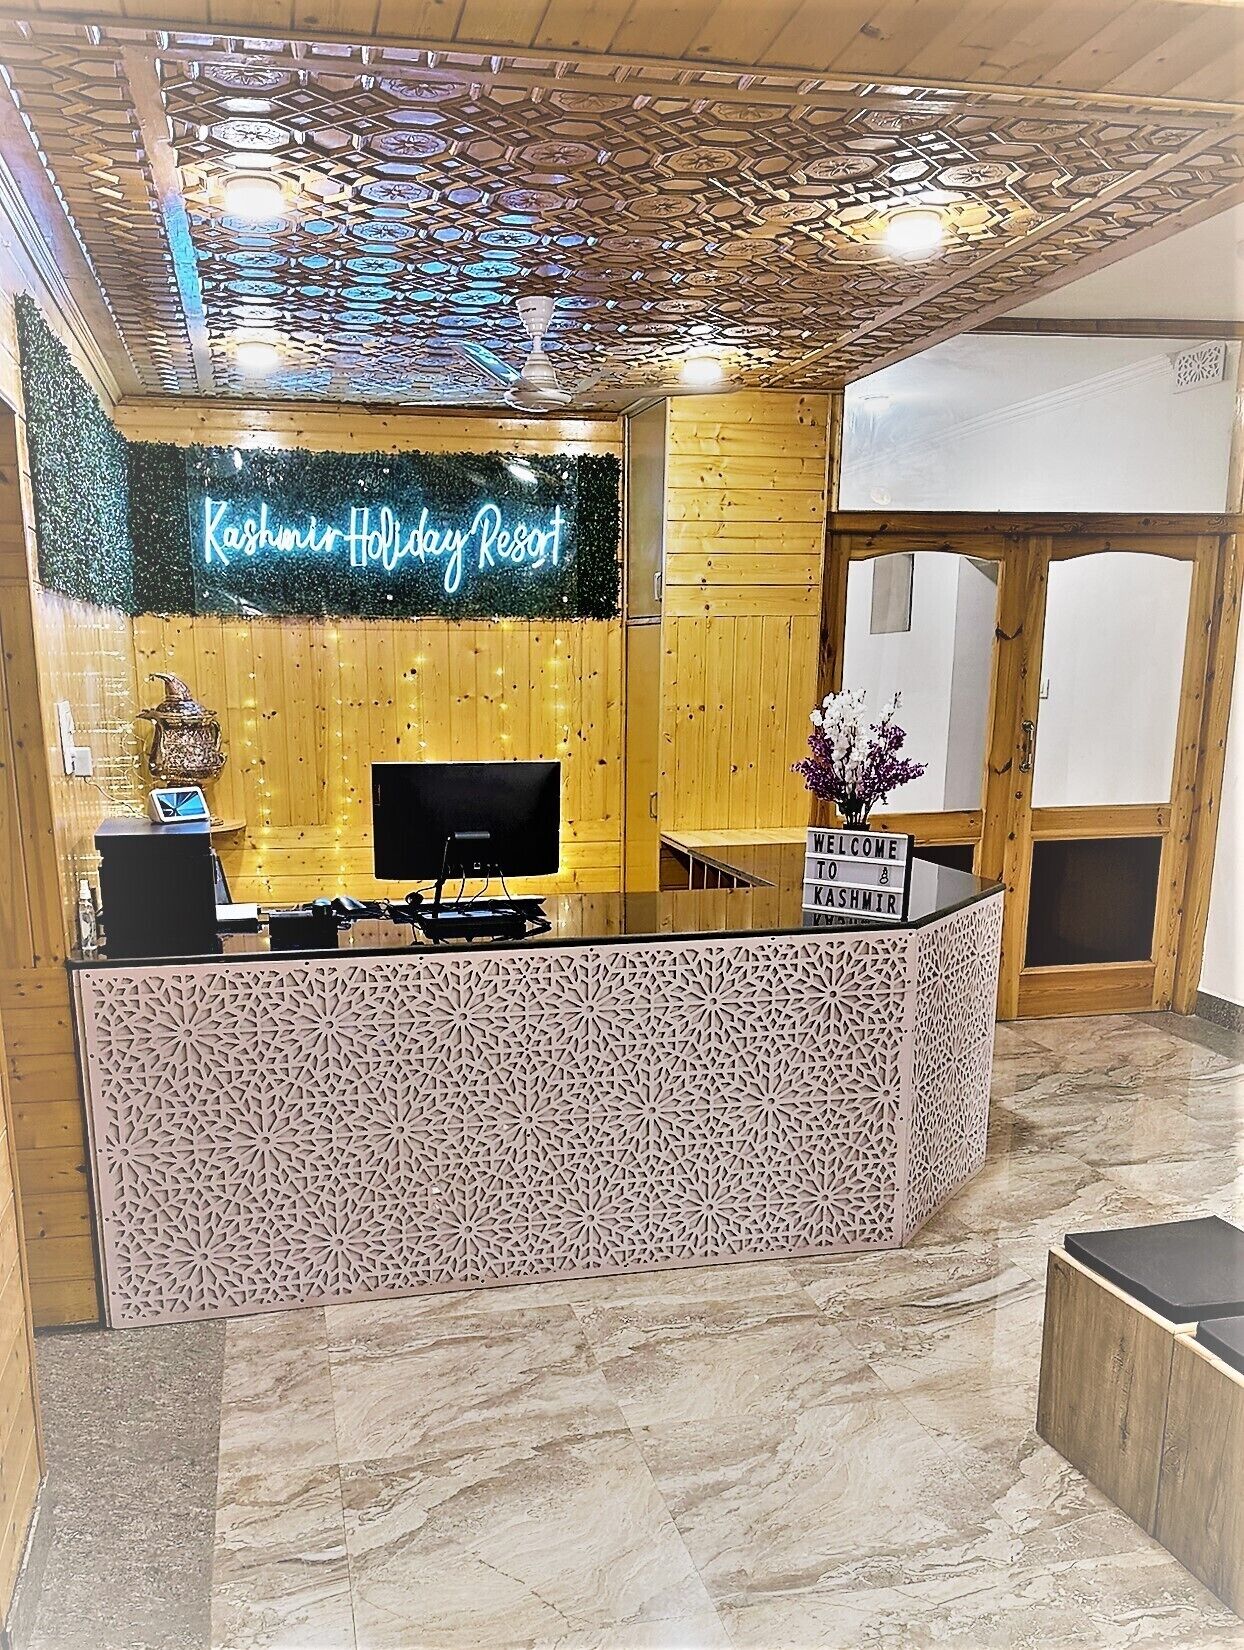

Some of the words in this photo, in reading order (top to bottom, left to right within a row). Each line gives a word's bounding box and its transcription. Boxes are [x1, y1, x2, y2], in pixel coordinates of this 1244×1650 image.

[204, 497, 345, 567] Kashmir
[344, 506, 470, 594] Holiday
[470, 503, 565, 569] Resort
[813, 833, 897, 859] WELCOME
[816, 860, 838, 880] TO
[813, 886, 896, 914] KASHMIR
